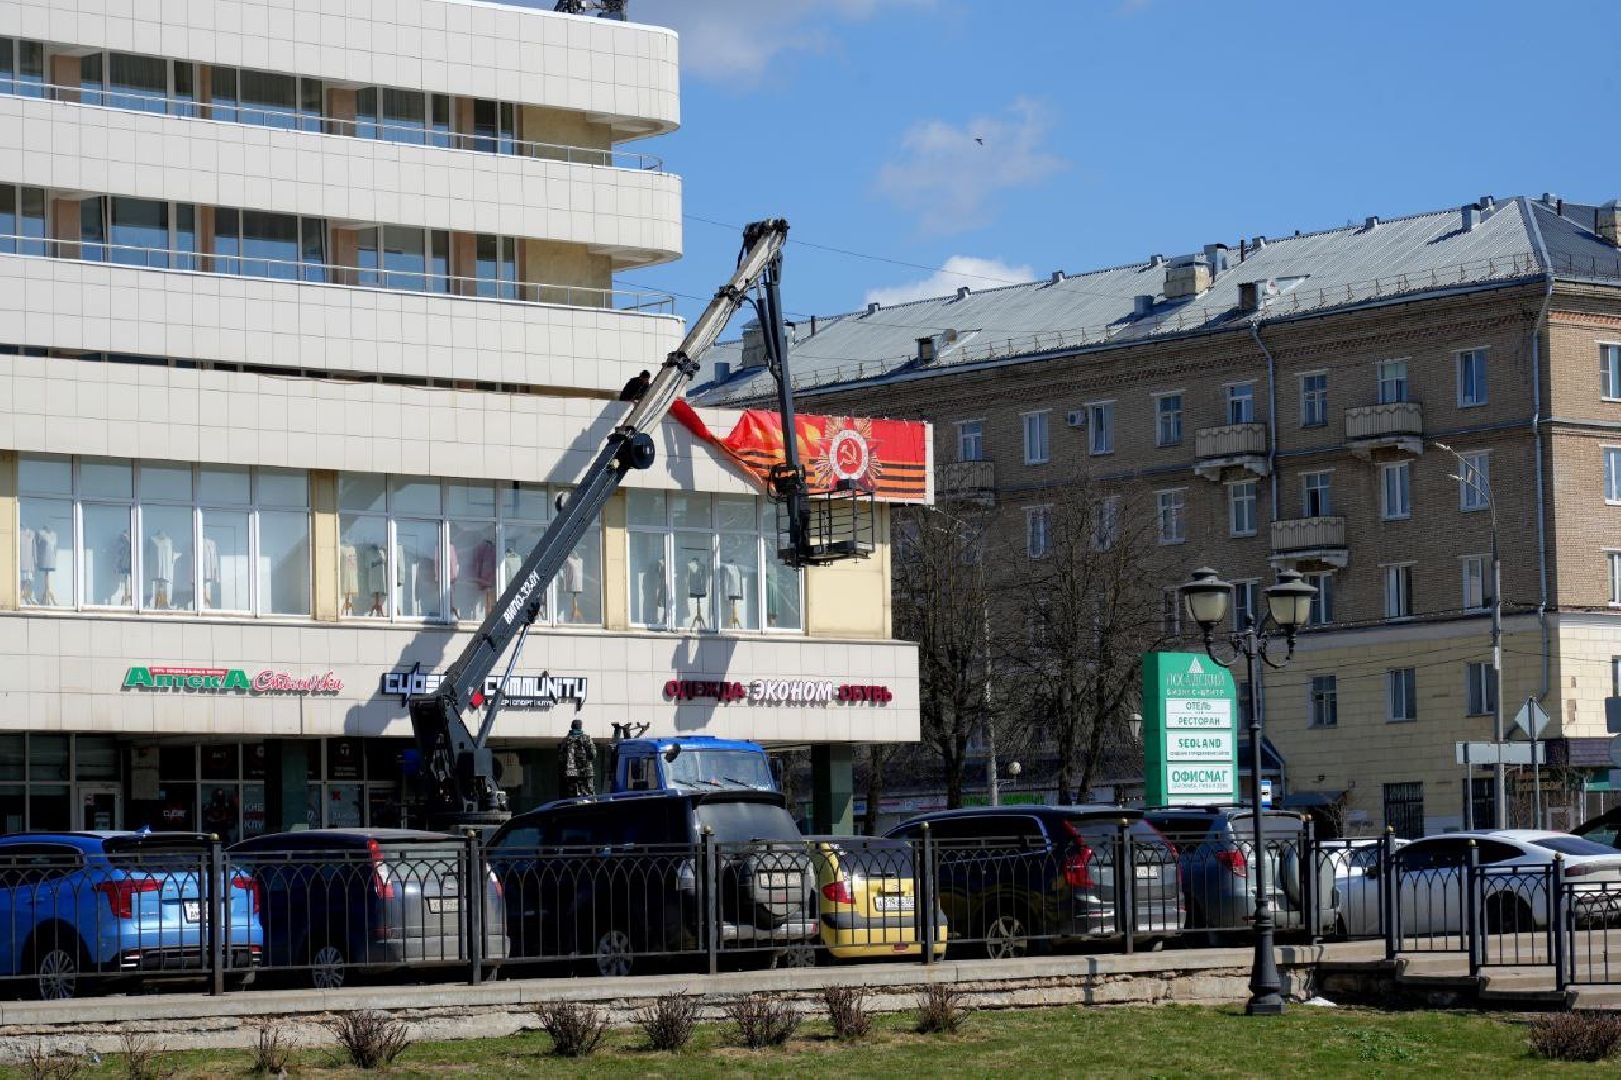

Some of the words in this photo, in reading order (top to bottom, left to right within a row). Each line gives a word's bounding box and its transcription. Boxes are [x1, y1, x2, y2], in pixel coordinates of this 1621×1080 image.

[665, 680, 746, 701] ОДЕЖДА
[753, 680, 833, 702] ЭКОНОМ
[838, 684, 893, 703] ОБУВЬ
[1185, 701, 1212, 711] ОТЕЛЬ
[1178, 716, 1221, 726] РЕСТОРАН
[1178, 738, 1222, 749] SEOLAND
[1171, 770, 1229, 783] ОФИСМАГ
